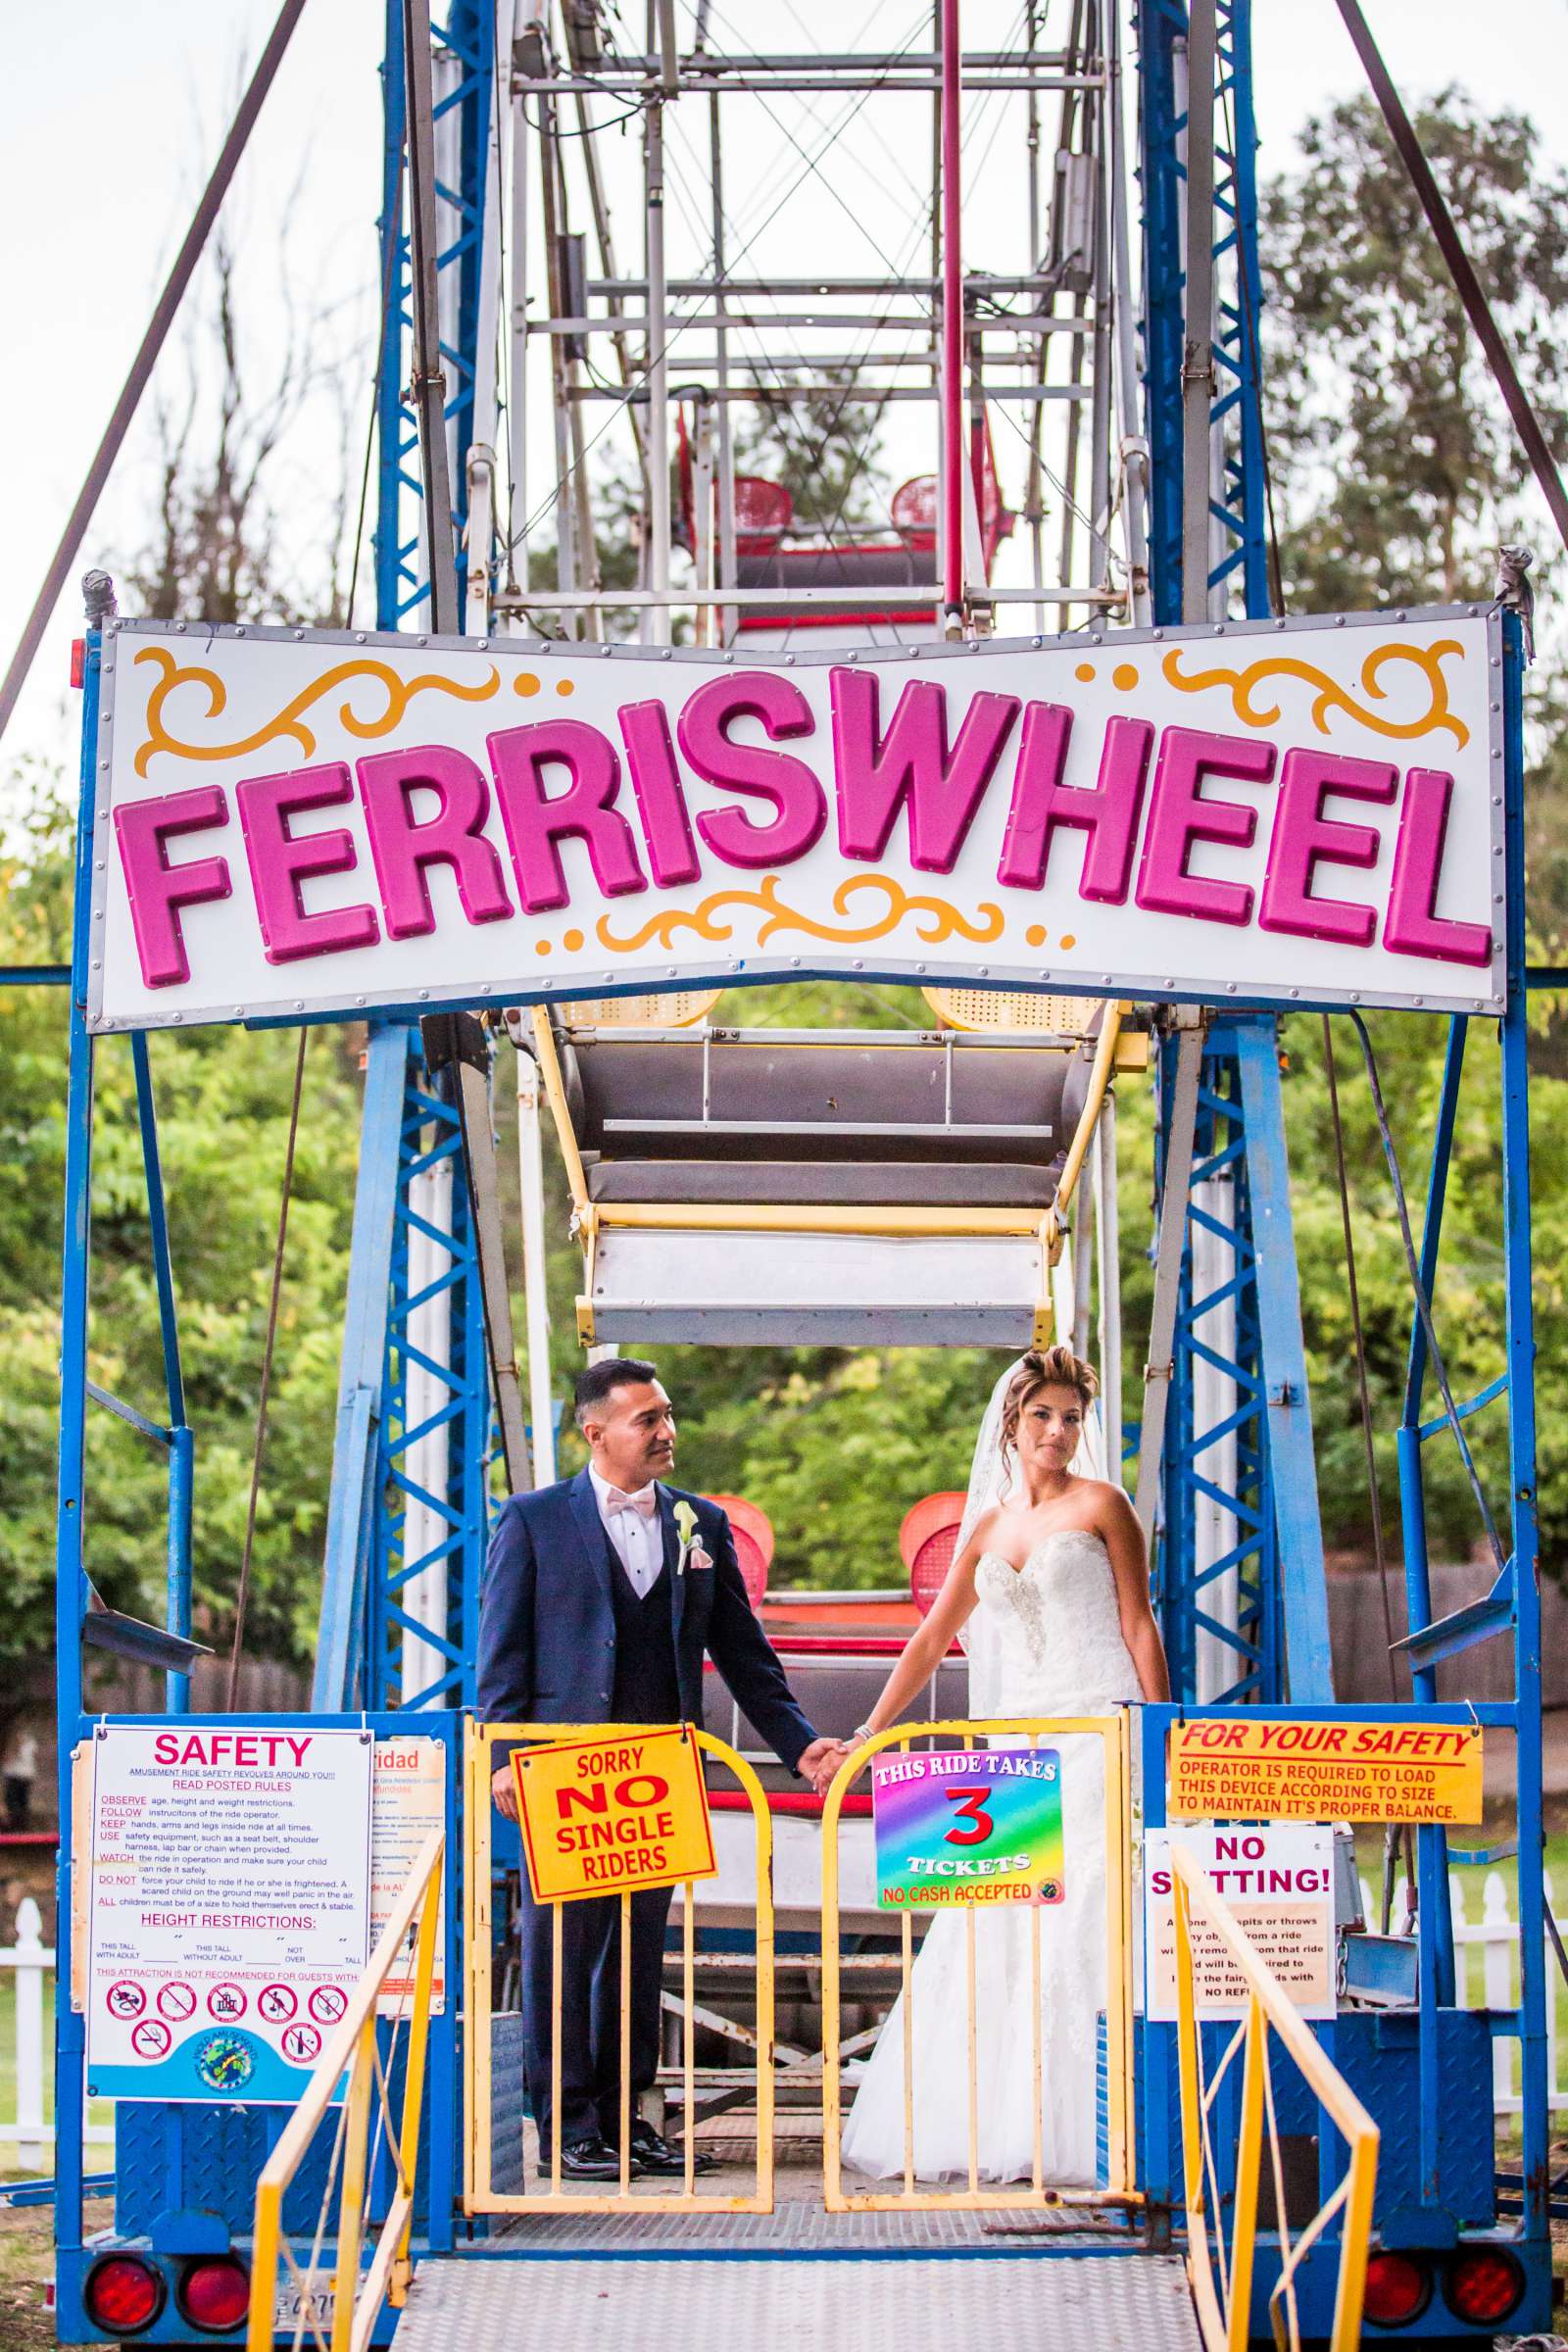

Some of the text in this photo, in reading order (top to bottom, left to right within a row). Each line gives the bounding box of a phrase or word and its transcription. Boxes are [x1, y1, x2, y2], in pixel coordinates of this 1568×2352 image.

[154, 1734, 313, 1767] SAFETY
[1181, 1723, 1470, 1757] FOR YOUR SAFETY
[129, 1768, 180, 1776] AMUSEMENT
[576, 1746, 644, 1779] SORRY
[875, 1755, 1057, 1788] THIS RIDE TAKES
[1180, 1762, 1435, 1783] OPERATOR IS REQUIRED TO LOAD
[173, 1780, 292, 1792] READ POSTED RULES
[1179, 1779, 1435, 1801] THIS DEVICE ACCORDING TO SIZE
[102, 1796, 147, 1805] OBSERVE
[172, 1798, 197, 1806] height
[217, 1799, 245, 1807] weight
[555, 1775, 670, 1819] NO
[1178, 1796, 1197, 1809] TO
[1203, 1798, 1281, 1812] MAINTAIN
[1287, 1800, 1315, 1814] IT'S
[1386, 1804, 1457, 1818] BALANCE.
[101, 1808, 142, 1817] FOLLOW
[944, 1787, 993, 1846] 3
[101, 1820, 126, 1828] KEEP
[202, 1822, 219, 1831] legs
[556, 1812, 675, 1854] SINGLE
[101, 1832, 119, 1840] USE
[126, 1833, 150, 1841] safety
[100, 1854, 133, 1862] WATCH
[1215, 1837, 1265, 1860] NO
[182, 1867, 206, 1875] safely.
[583, 1846, 667, 1882] RIDERS
[906, 1853, 1030, 1879] TICKETS
[99, 1875, 113, 1884] DO
[116, 1876, 136, 1885] NOT
[294, 1880, 338, 1888] frightened.
[1152, 1869, 1330, 1894] STTING!
[98, 1897, 116, 1906] ALL
[883, 1886, 905, 1903] NO
[906, 1886, 950, 1903] CASH
[953, 1883, 1032, 1902] ACCEPTED
[142, 1914, 316, 1928] HEIGHT RESTRICTIONS:
[119, 1969, 172, 1977] ATTRACTION
[206, 1971, 275, 1980] RECOMMENDED
[278, 1972, 295, 1980] FOR
[298, 1973, 333, 1981] GUESTS
[335, 1974, 359, 1982] WITH:
